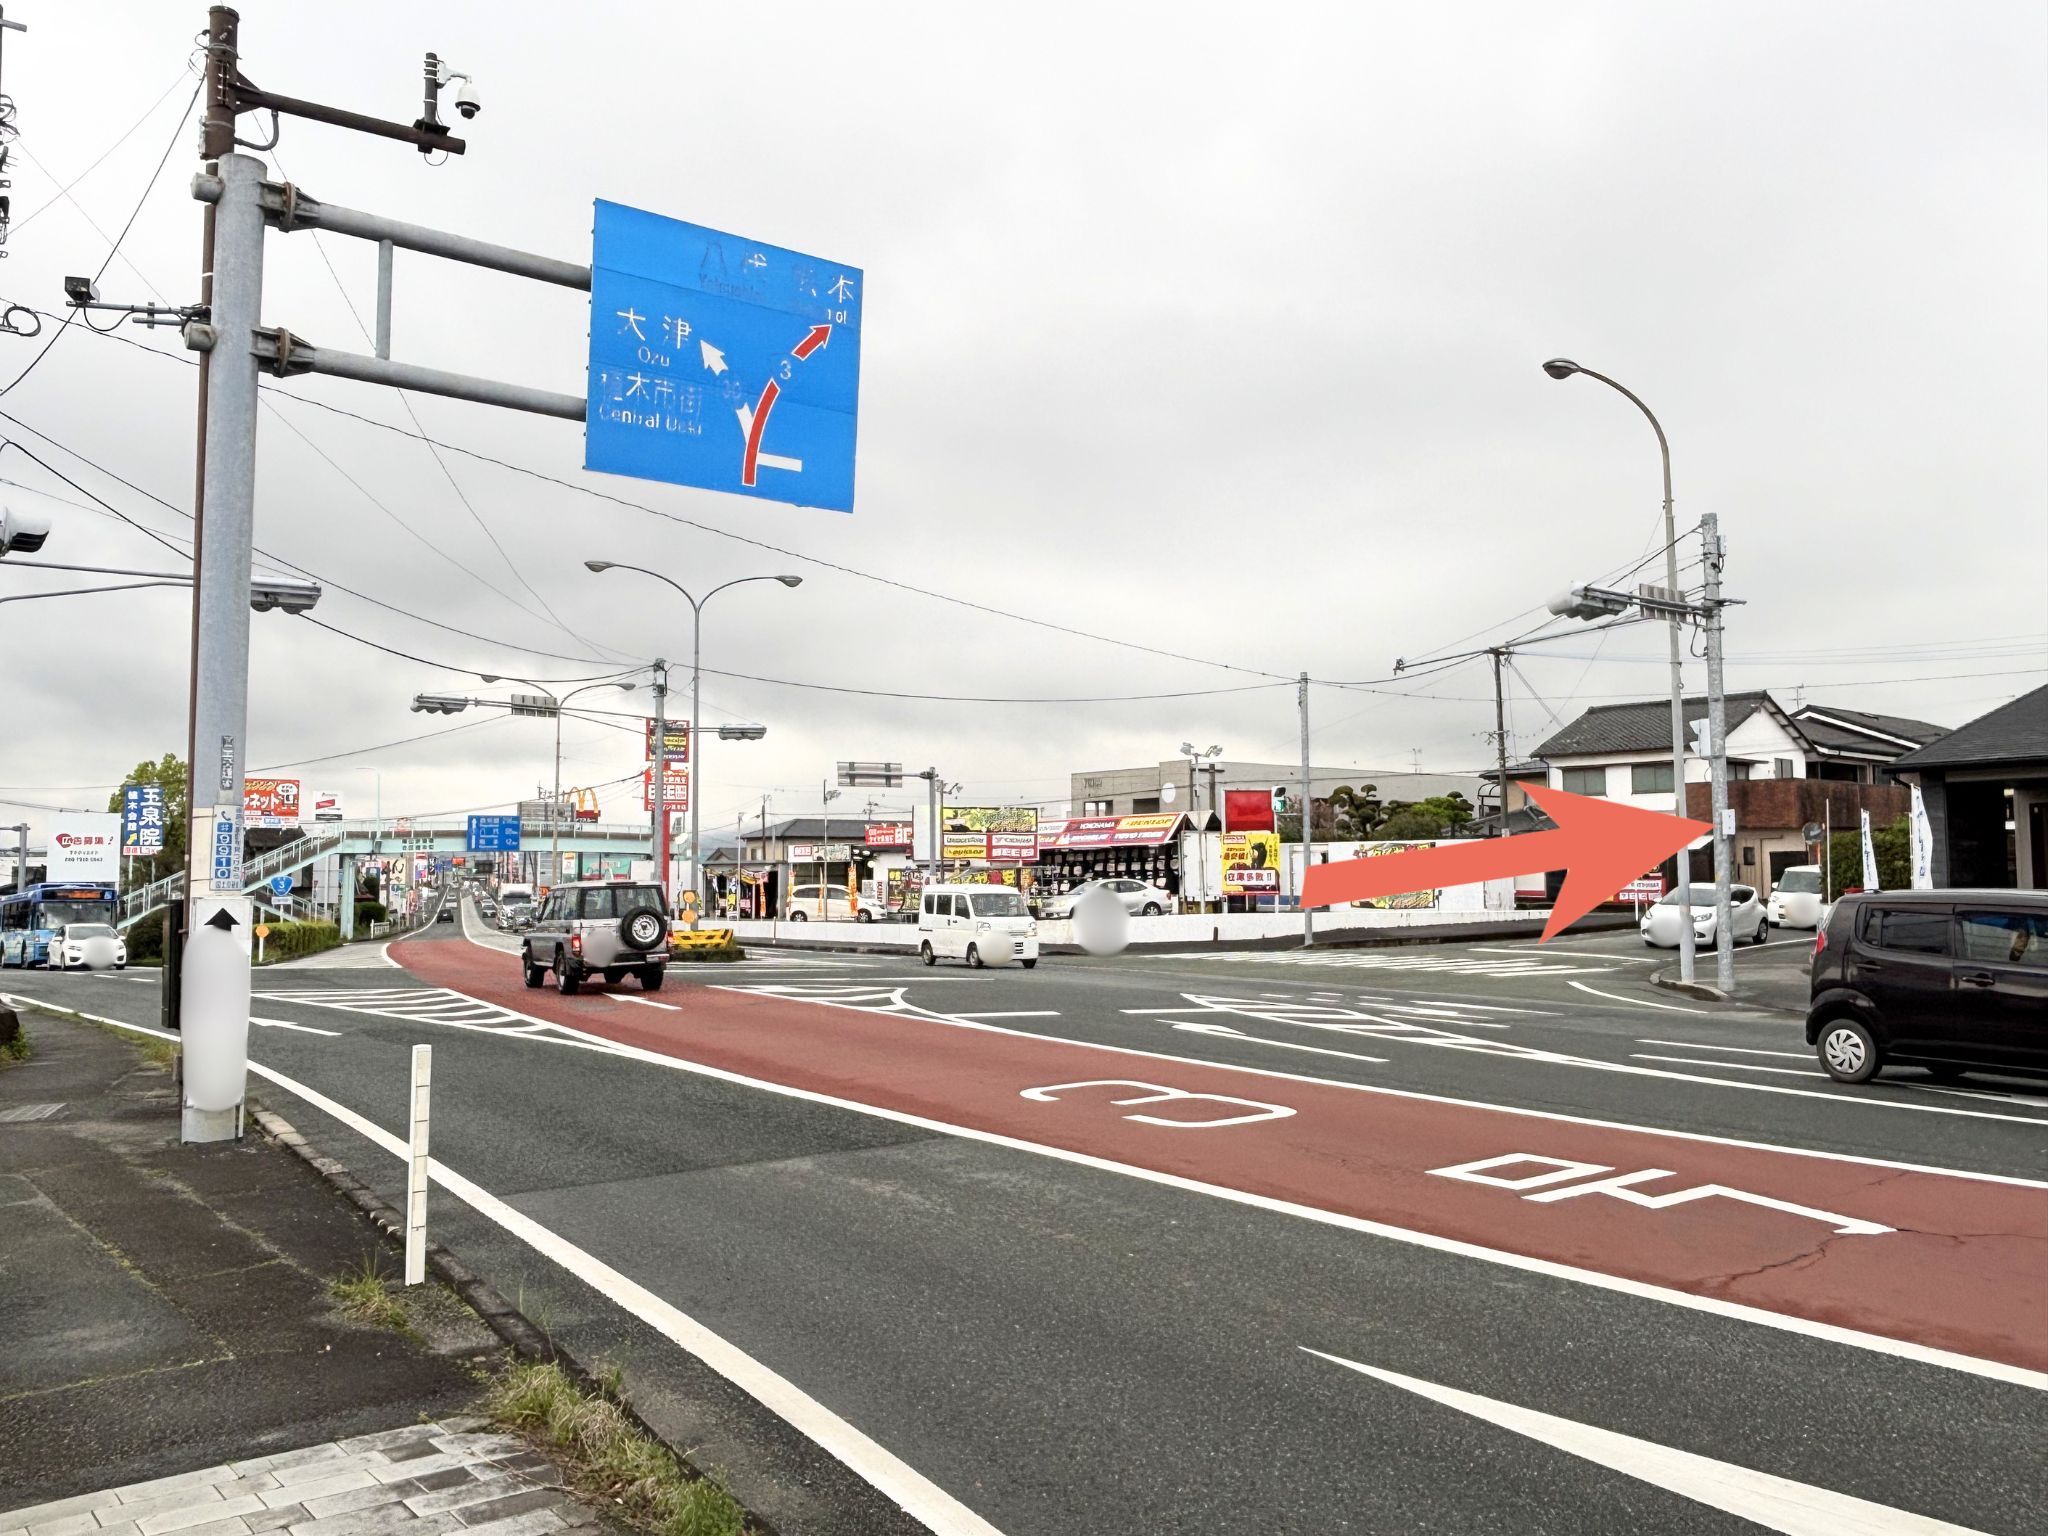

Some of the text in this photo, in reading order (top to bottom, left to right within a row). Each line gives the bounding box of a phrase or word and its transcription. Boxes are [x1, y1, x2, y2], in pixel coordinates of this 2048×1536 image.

[780, 360, 792, 380] 3
[140, 788, 163, 845] 玉泉院
